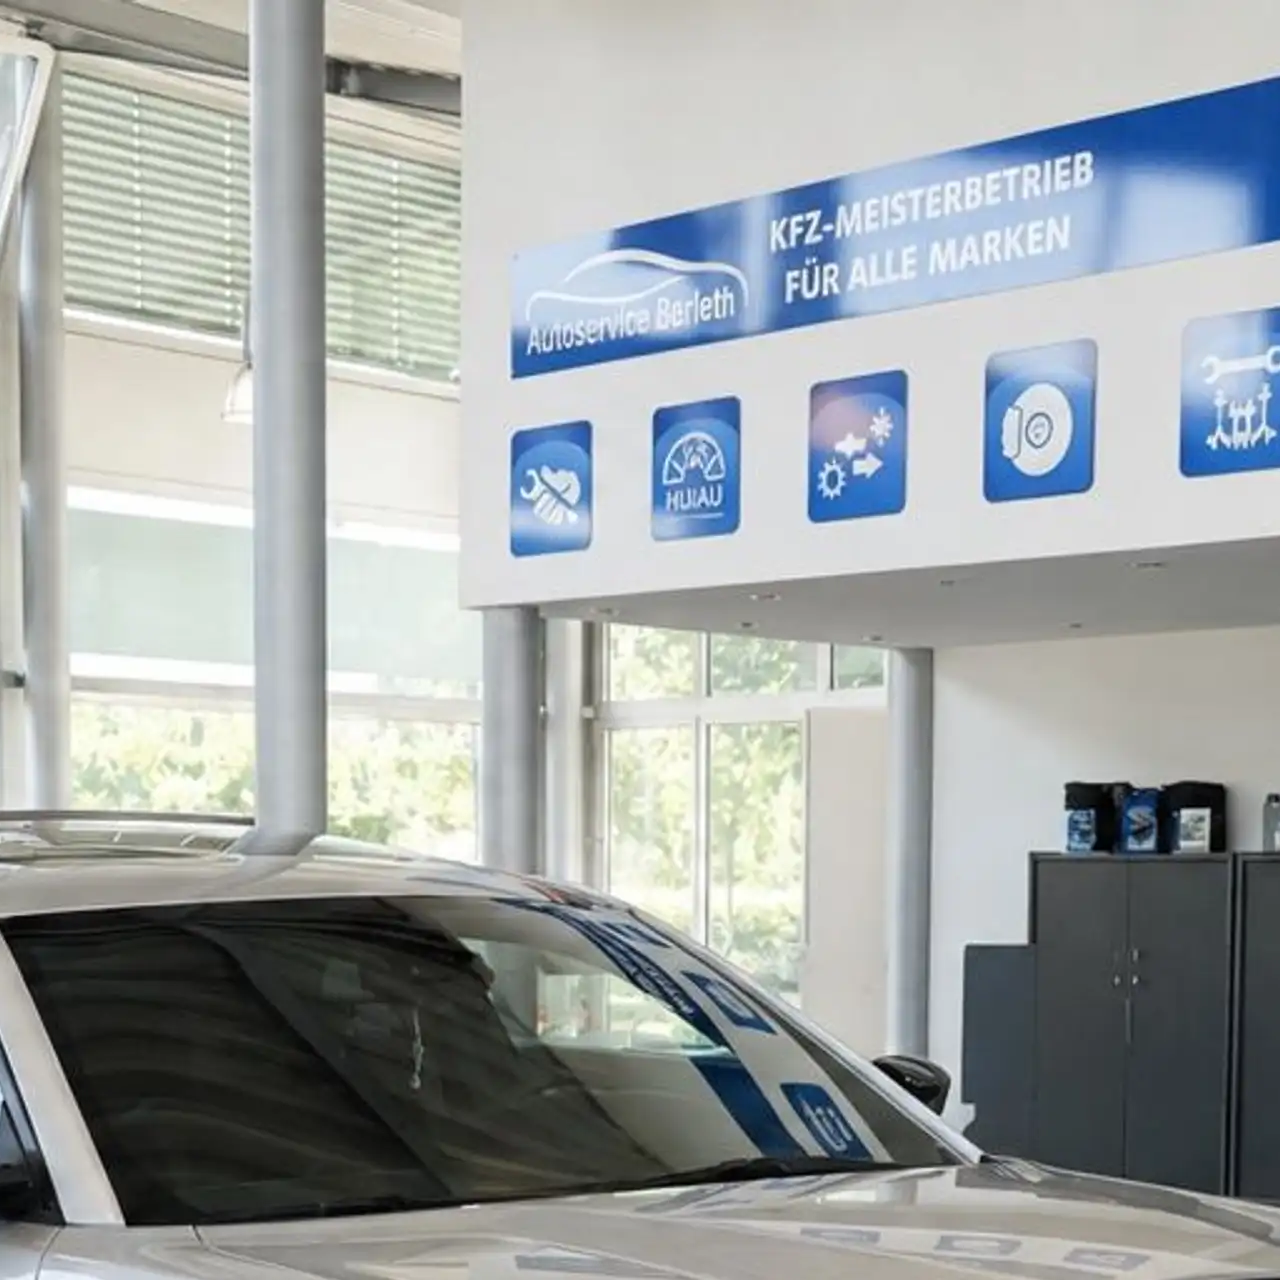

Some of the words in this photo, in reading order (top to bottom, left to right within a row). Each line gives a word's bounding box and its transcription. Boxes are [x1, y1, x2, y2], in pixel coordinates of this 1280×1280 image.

[770, 150, 1094, 253] KFZ-MEISTERBETRIEB
[784, 257, 840, 304] FÜR
[847, 245, 918, 292] ALLE
[928, 215, 1071, 276] MARKEN
[526, 302, 651, 356] Autoservice
[656, 286, 735, 330] Berleth
